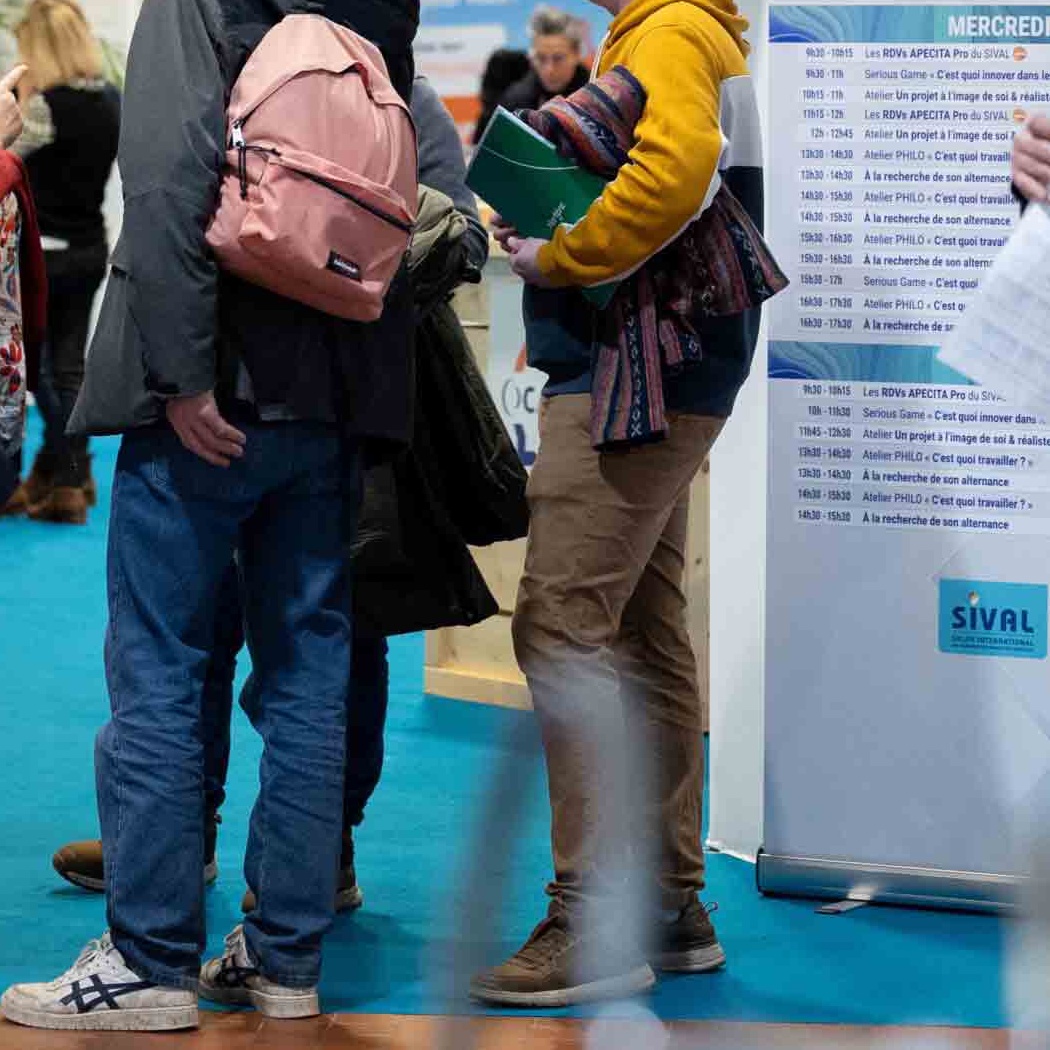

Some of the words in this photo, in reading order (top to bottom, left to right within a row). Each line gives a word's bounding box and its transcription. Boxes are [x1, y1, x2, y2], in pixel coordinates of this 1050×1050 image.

[865, 49, 880, 58] Les
[883, 48, 907, 58] RDVs
[910, 48, 950, 58] APECITA
[953, 49, 969, 58] Pro
[984, 48, 1009, 59] SIVAL
[865, 70, 898, 78] Serious
[900, 70, 927, 79] Game
[937, 70, 959, 80] C'est
[961, 70, 980, 82] quoi
[982, 72, 1015, 80] innover
[1017, 70, 1039, 80] dans
[865, 90, 894, 100] Atelier
[896, 90, 908, 100] Un
[911, 91, 938, 102] projet
[996, 92, 1008, 101] soi
[865, 110, 880, 120] Les
[883, 110, 906, 119] RDVs
[910, 110, 950, 120] APECITA
[953, 110, 968, 120] Pro
[984, 111, 1009, 121] SIVAL
[865, 130, 893, 138] Atelier
[896, 130, 908, 139] Un
[911, 130, 938, 141] projet
[995, 131, 1008, 140] soi
[864, 150, 893, 160] Atelier
[896, 150, 925, 160] PHILO
[935, 151, 957, 161] C'est
[959, 152, 978, 164] quoi
[884, 172, 930, 181] recherche
[964, 174, 1013, 182] alternance
[864, 192, 893, 202] Atelier
[896, 192, 924, 203] PHILO
[934, 193, 956, 203] C'est
[959, 194, 978, 206] quoi
[884, 214, 930, 224] recherche
[964, 216, 1010, 225] alternance
[864, 234, 893, 244] Atelier
[896, 234, 924, 245] PHILO
[934, 236, 956, 245] C'est
[958, 238, 977, 248] quoi
[884, 256, 930, 266] recherche
[946, 259, 961, 267] son
[864, 276, 898, 286] Serious
[900, 277, 926, 286] Game
[936, 278, 958, 288] C'est
[960, 278, 978, 290] quoi
[864, 299, 892, 308] Atelier
[895, 299, 924, 310] PHILO
[934, 300, 955, 310] C'est
[883, 321, 929, 330] recherche
[864, 387, 879, 397] Les
[882, 388, 906, 397] RDVs
[908, 388, 948, 398] APECITA
[950, 390, 966, 400] Pro
[862, 408, 897, 418] Serious
[935, 410, 956, 420] C'est
[958, 414, 977, 423] quoi
[1015, 414, 1036, 424] dans
[863, 430, 893, 439] Atelier
[895, 430, 907, 440] Un
[910, 431, 935, 443] projet
[862, 450, 893, 460] Atelier
[894, 451, 922, 462] PHILO
[932, 453, 954, 462] C'est
[957, 456, 976, 466] quoi
[978, 456, 1018, 466] travailler
[883, 472, 928, 483] recherche
[943, 476, 959, 484] son
[962, 476, 1009, 486] alternance
[862, 492, 892, 502] Atelier
[894, 494, 922, 504] PHILO
[932, 495, 954, 505] C'est
[956, 497, 975, 508] quoi
[978, 498, 1018, 508] travailler
[882, 514, 928, 525] recherche
[961, 519, 1009, 529] alternance
[951, 606, 1034, 633] SIVAL
